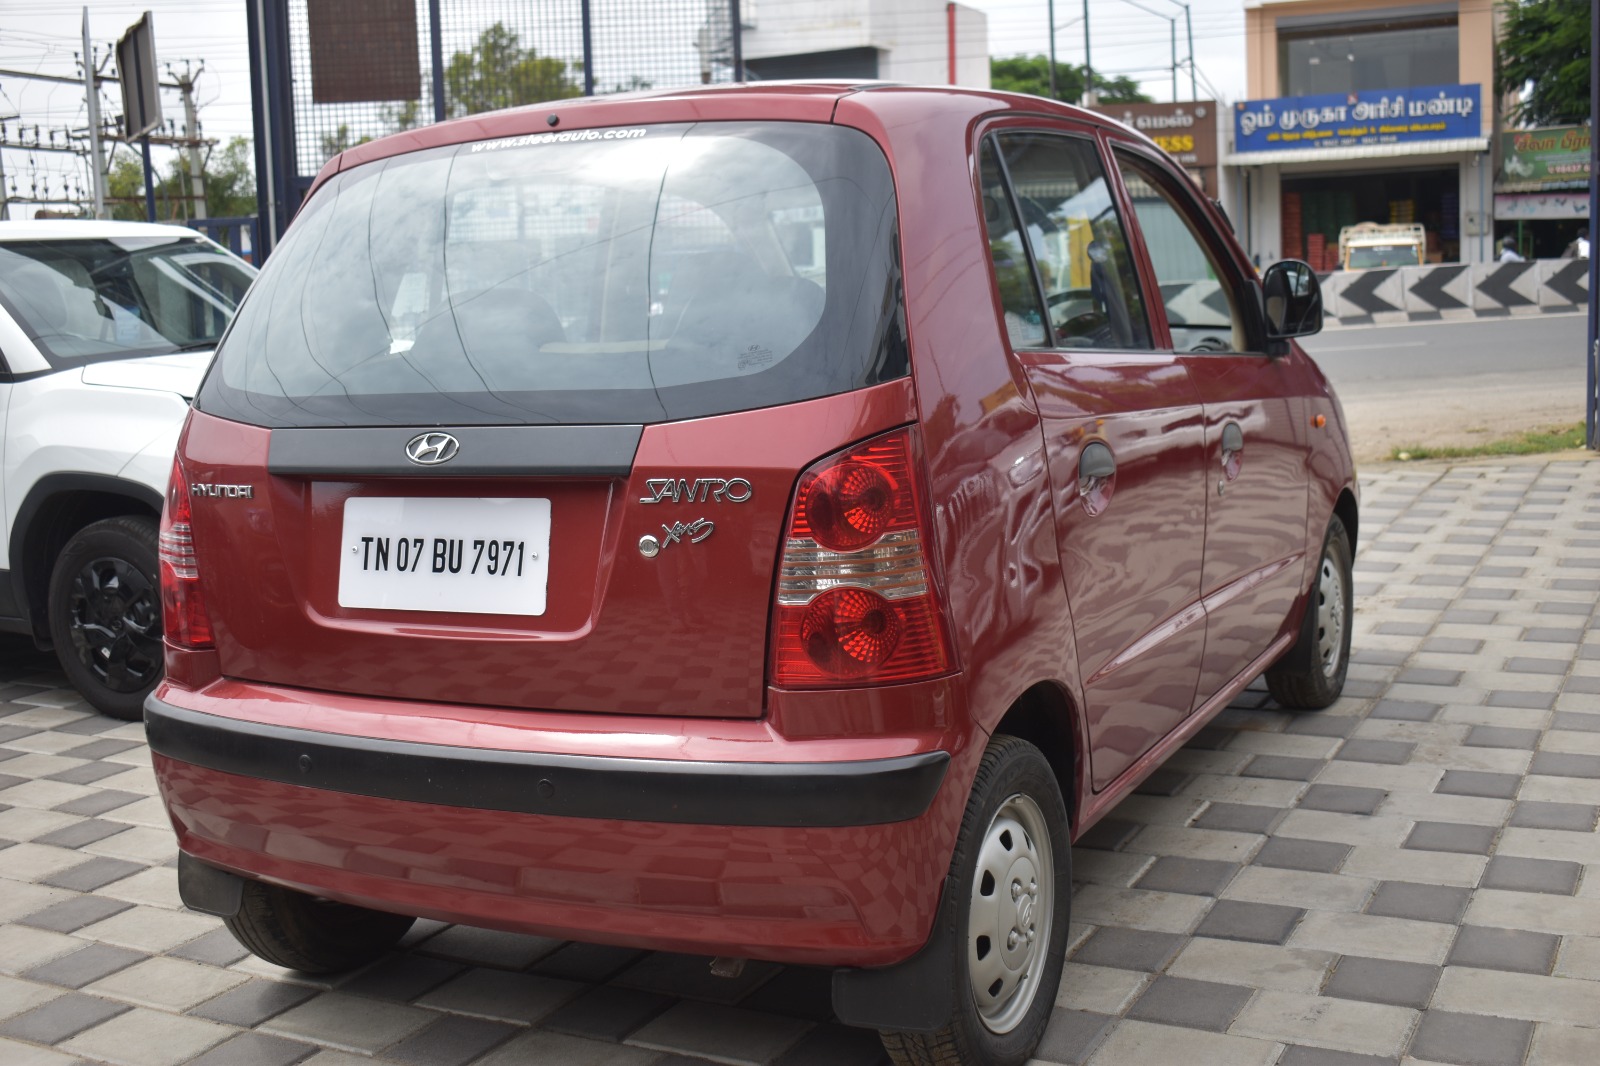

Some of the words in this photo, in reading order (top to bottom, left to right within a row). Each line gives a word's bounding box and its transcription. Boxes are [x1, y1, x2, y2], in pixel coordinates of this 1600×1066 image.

[1241, 104, 1276, 135] ஓம்
[1279, 106, 1347, 130] முருகா
[1352, 96, 1405, 120] அரிசி
[1409, 91, 1473, 117] மண்டி
[471, 128, 647, 152] www.steerauto.com
[1152, 135, 1194, 152] ESS
[191, 483, 252, 498] HYUNDAI
[639, 478, 752, 503] SANTRO
[361, 537, 390, 571] TN
[396, 538, 425, 573] 07
[432, 538, 463, 574] BU
[471, 540, 525, 577] 7971
